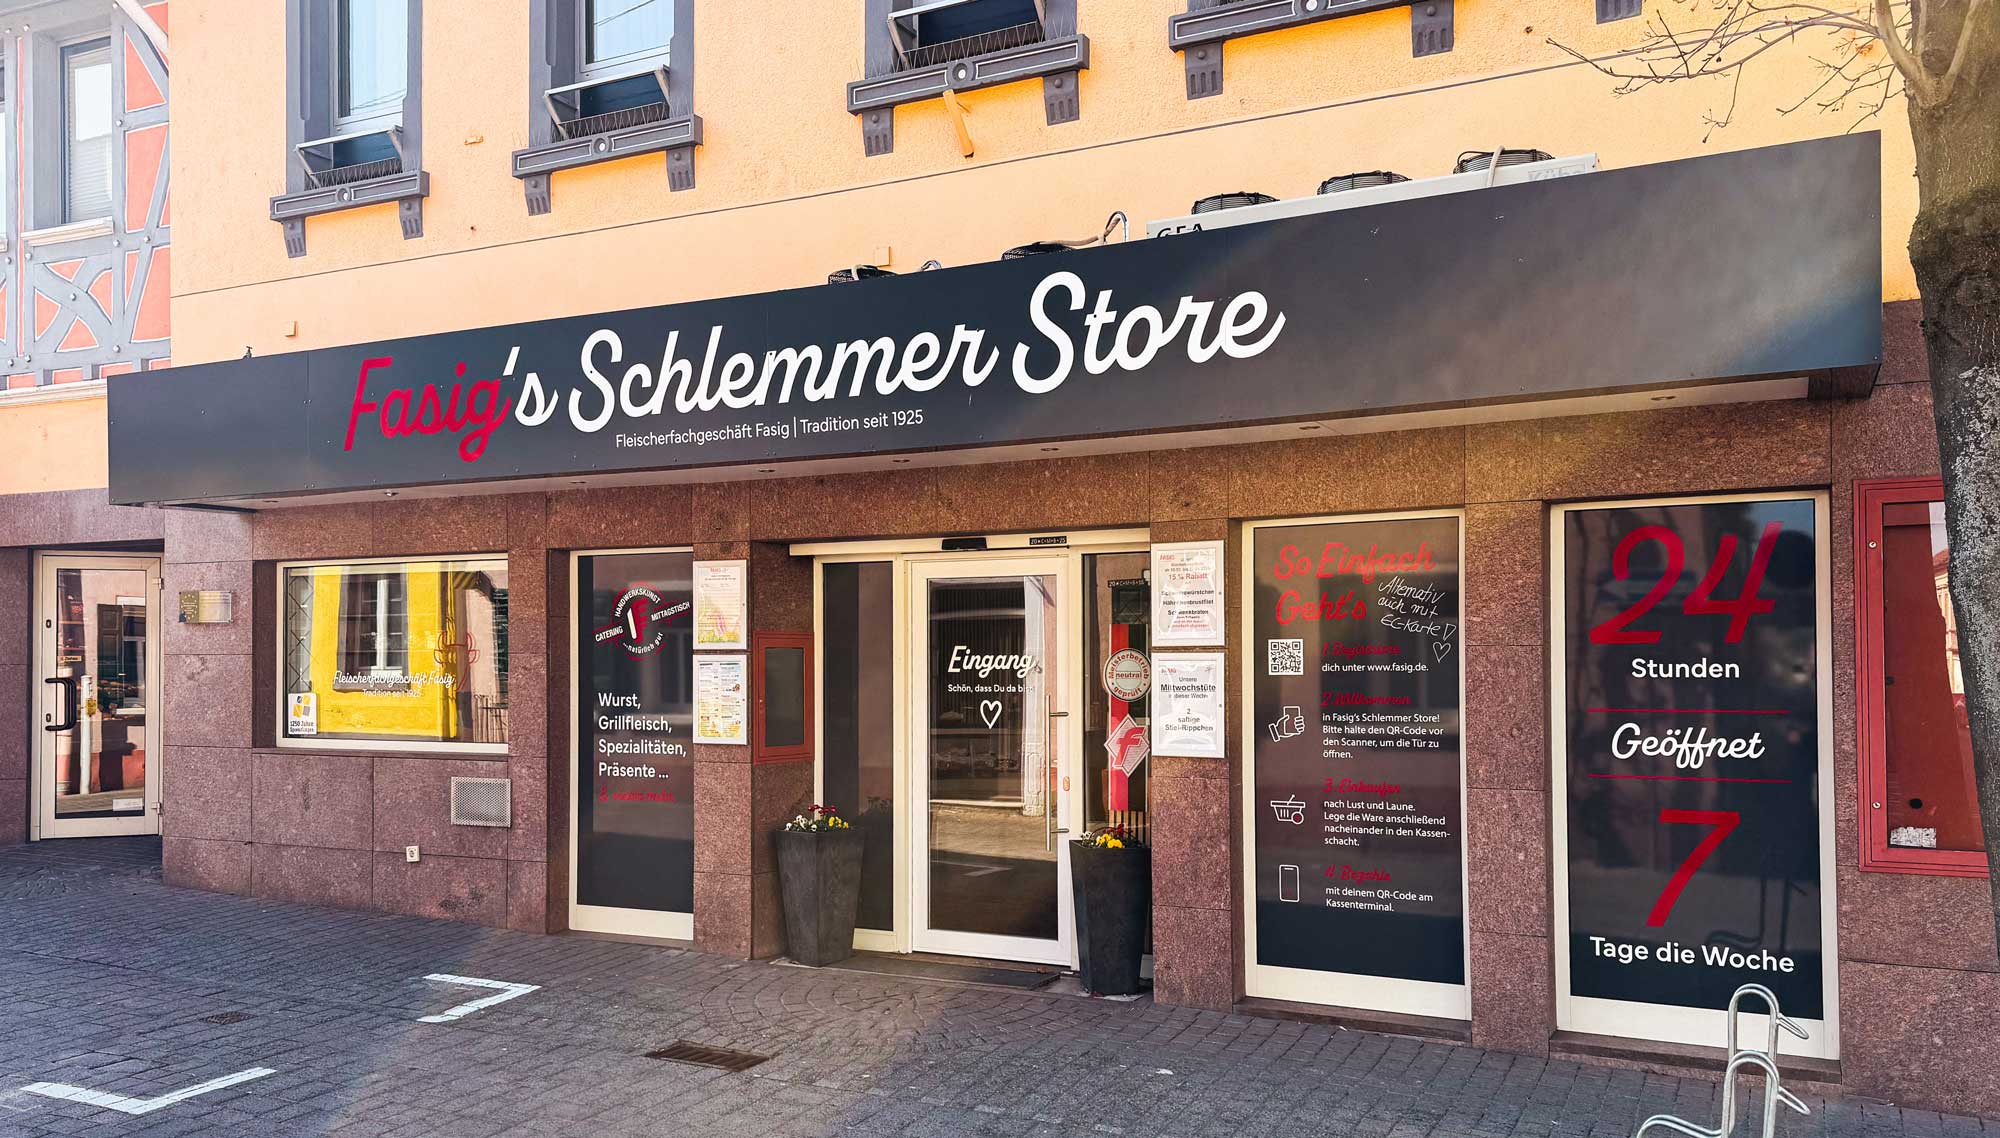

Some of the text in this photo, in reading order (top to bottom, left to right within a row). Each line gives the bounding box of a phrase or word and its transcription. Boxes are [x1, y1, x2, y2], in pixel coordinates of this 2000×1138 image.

[344, 271, 1287, 463] Fasig's Schlemmer Store
[615, 408, 924, 449] Fleischerfachgeschäft Fasig Tradition seit 1925
[1274, 541, 1437, 585] So Einfach
[1589, 520, 1784, 645] 24
[650, 601, 691, 622] MITTAGSTISCH
[1275, 589, 1367, 625] Geht's
[1377, 596, 1439, 619] auch mit
[595, 625, 624, 642] CATERING
[947, 645, 1036, 679] Eingang
[1108, 653, 1149, 679] Meisterbetrieb
[1322, 662, 1429, 673] dich unter www.fasig.de.
[1631, 657, 1741, 678] Stunden
[428, 671, 455, 689] Fasig
[947, 684, 973, 693] Schön,
[974, 684, 992, 692] dass
[993, 684, 1005, 692] Du
[1006, 684, 1016, 692] da
[598, 692, 641, 709] Wurst,
[1113, 686, 1142, 698] geprüft
[598, 715, 672, 734] Grillfleisch,
[1322, 713, 1440, 723] in Fasig's Schlemmer Store!
[1322, 725, 1342, 734] Bitte
[1344, 725, 1366, 734] halte
[1368, 725, 1385, 735] den
[1387, 725, 1427, 735] QR-Code
[598, 739, 686, 757] Spezialitäten,
[1323, 737, 1340, 746] den
[1341, 737, 1378, 748] Scanner,
[1396, 738, 1410, 748] die
[1411, 738, 1426, 748] Tür
[1428, 740, 1440, 748] zu
[1611, 722, 1766, 769] Geöffnet
[1322, 749, 1353, 759] öffnen.
[598, 762, 656, 777] Präsente
[1324, 800, 1416, 811] nach Lust und Laune.
[1324, 812, 1446, 825] Lege die Ware anschließend
[1324, 824, 1451, 838] nacheinander in den Kassen-
[1324, 837, 1360, 846] schacht.
[1645, 808, 1741, 927] 7
[1325, 887, 1433, 902] mit deinem QR-Code am
[1326, 898, 1395, 912] Kassenterminal.
[1589, 936, 1795, 973] Tage die Woche
